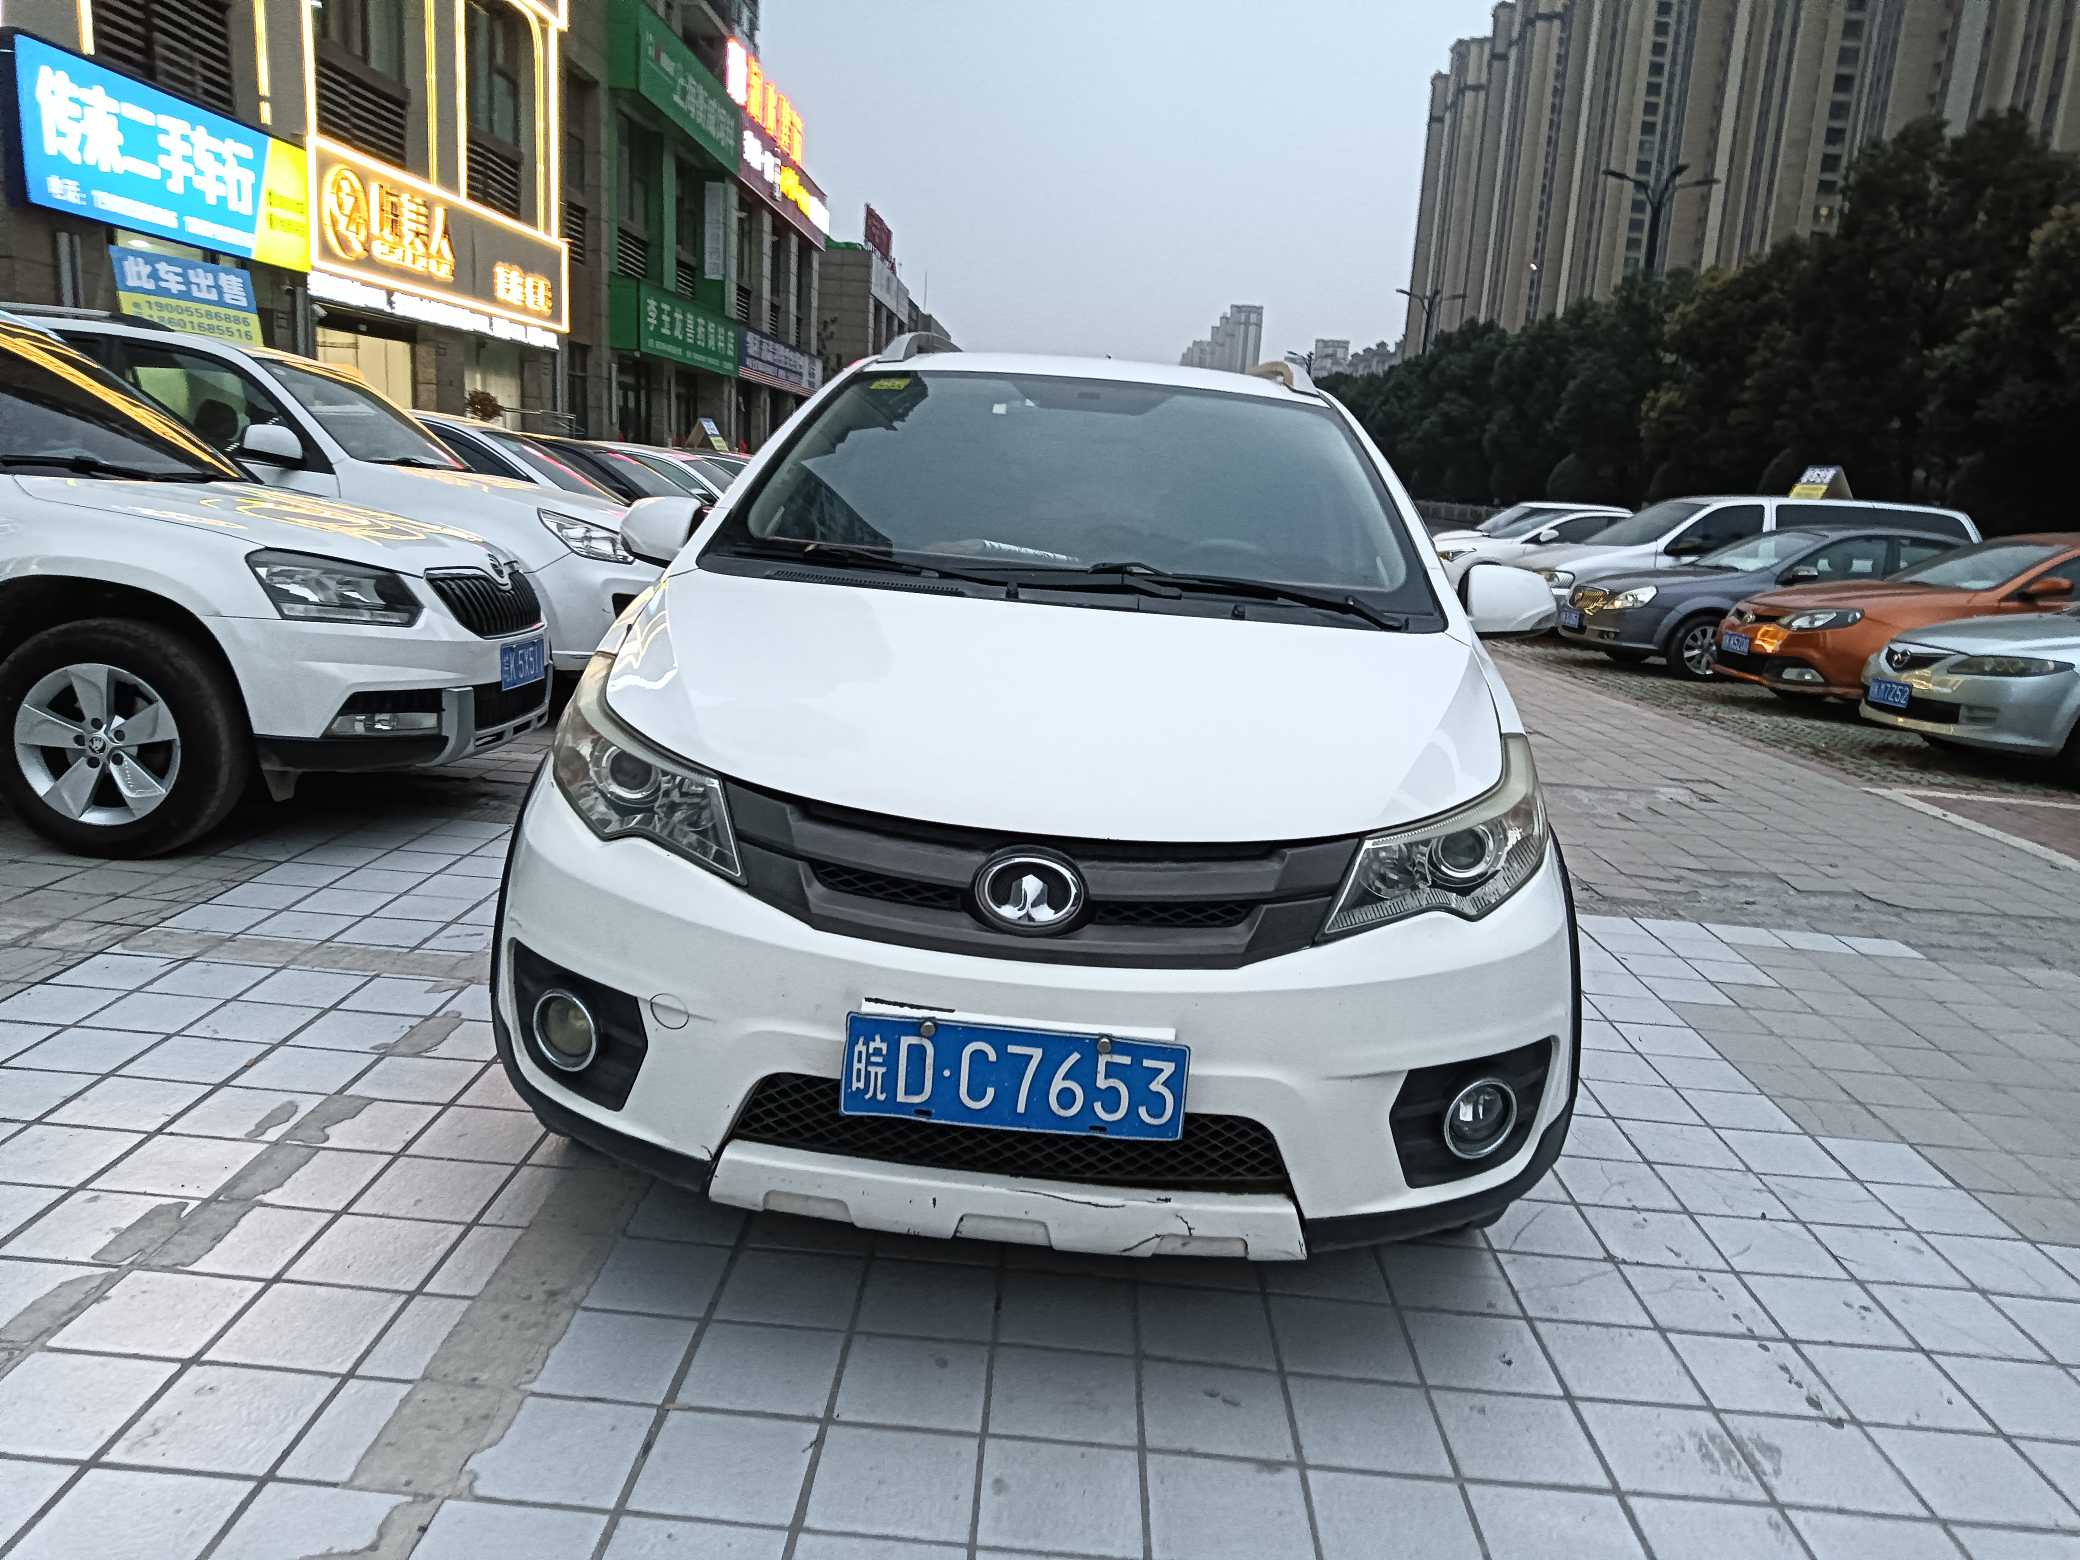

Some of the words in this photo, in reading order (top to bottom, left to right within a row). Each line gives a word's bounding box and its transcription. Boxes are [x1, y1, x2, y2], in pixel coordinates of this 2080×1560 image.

[122, 255, 248, 307] 此车出售
[851, 1033, 1176, 1126] 皖D·C7653
